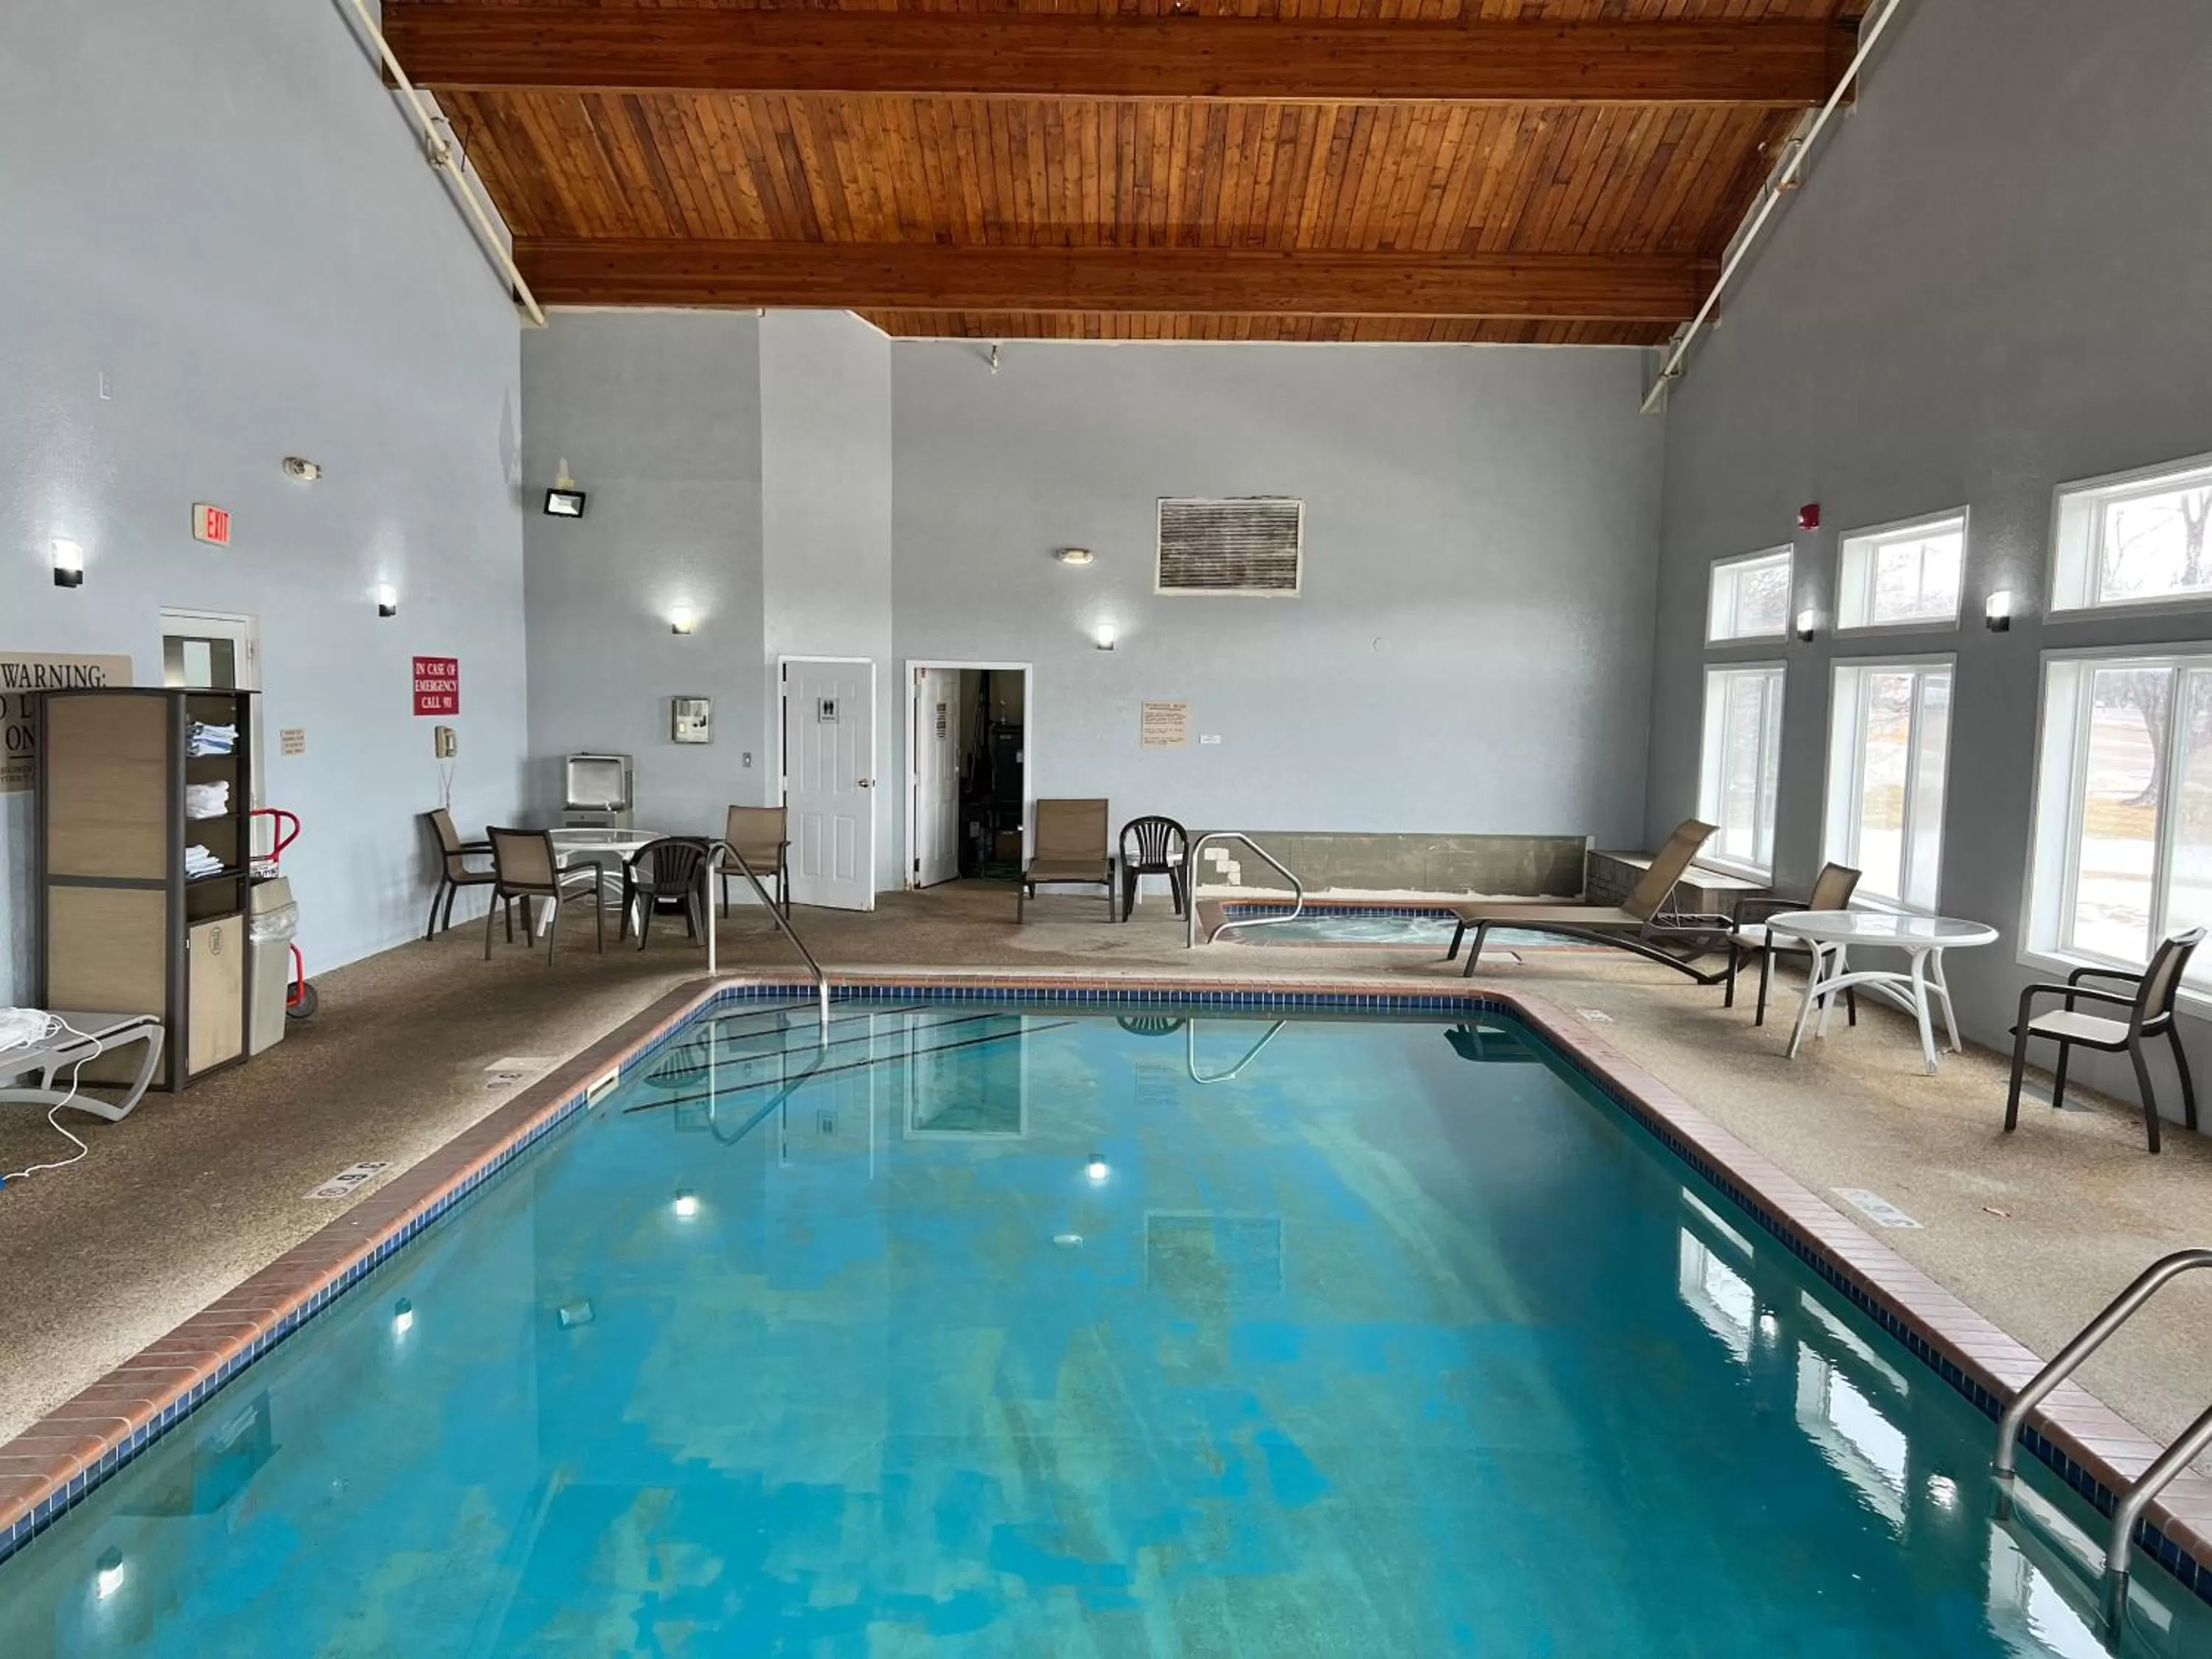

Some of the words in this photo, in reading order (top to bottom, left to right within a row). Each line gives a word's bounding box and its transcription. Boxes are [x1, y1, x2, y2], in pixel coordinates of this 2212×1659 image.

[206, 507, 229, 543] EXIT
[1, 663, 105, 688] WARNING:
[415, 663, 425, 675] IN
[428, 663, 445, 675] CASE
[447, 664, 456, 675] OF
[414, 679, 456, 692] EMERGENCY
[422, 696, 442, 708] CALL
